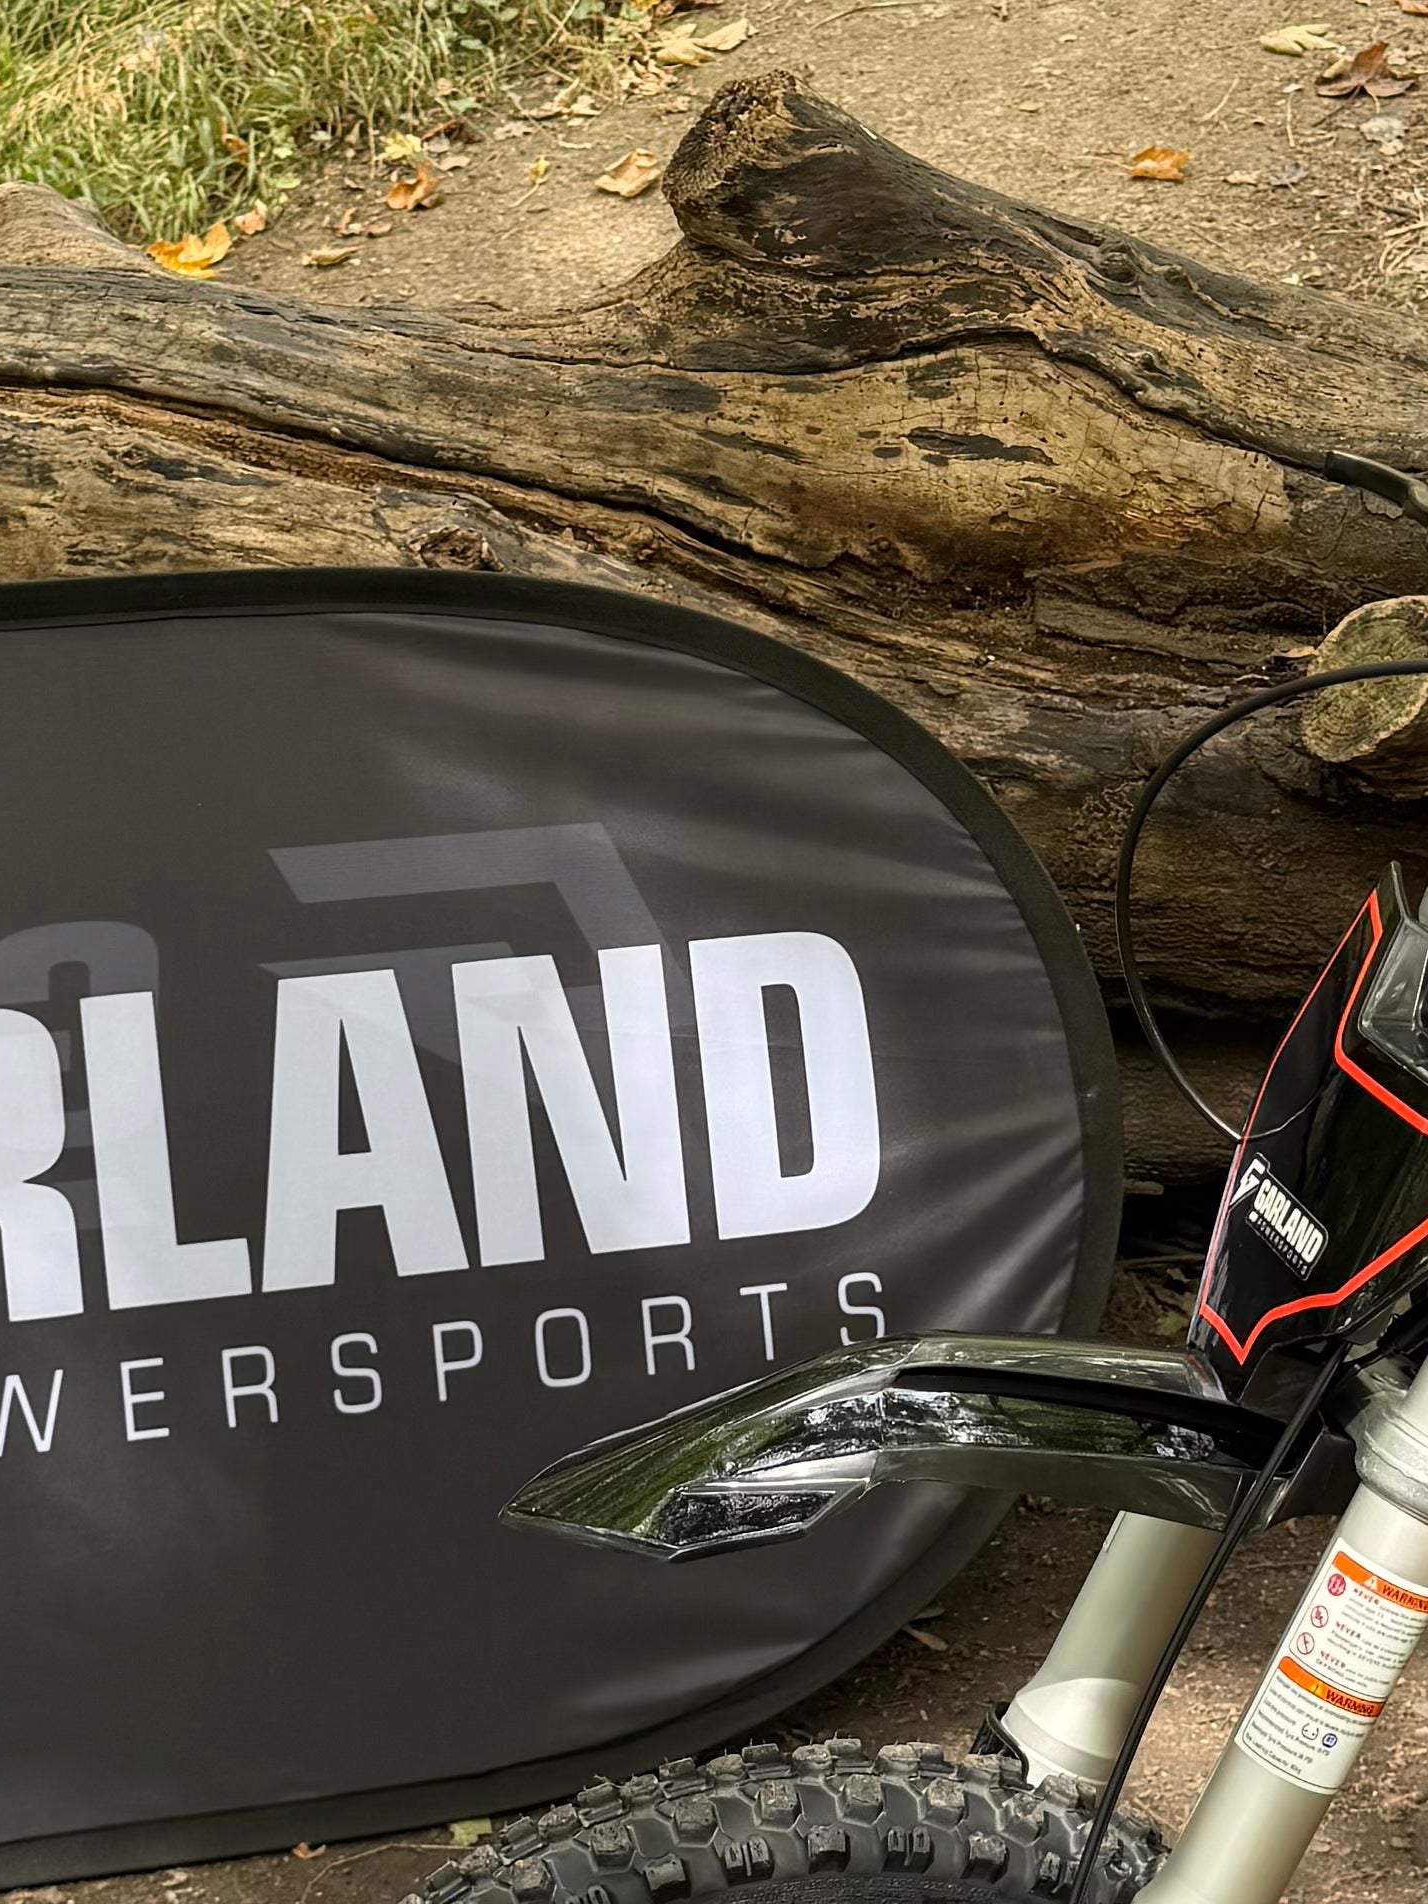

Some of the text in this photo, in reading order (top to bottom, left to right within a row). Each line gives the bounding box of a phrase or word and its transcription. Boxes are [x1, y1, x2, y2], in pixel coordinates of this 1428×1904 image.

[1253, 1178, 1323, 1263] GARLAND
[1353, 1587, 1379, 1605] NEVER
[1335, 1620, 1361, 1639] NEVER
[1320, 1650, 1346, 1668] NEVER
[1325, 1689, 1374, 1714] WARNING
